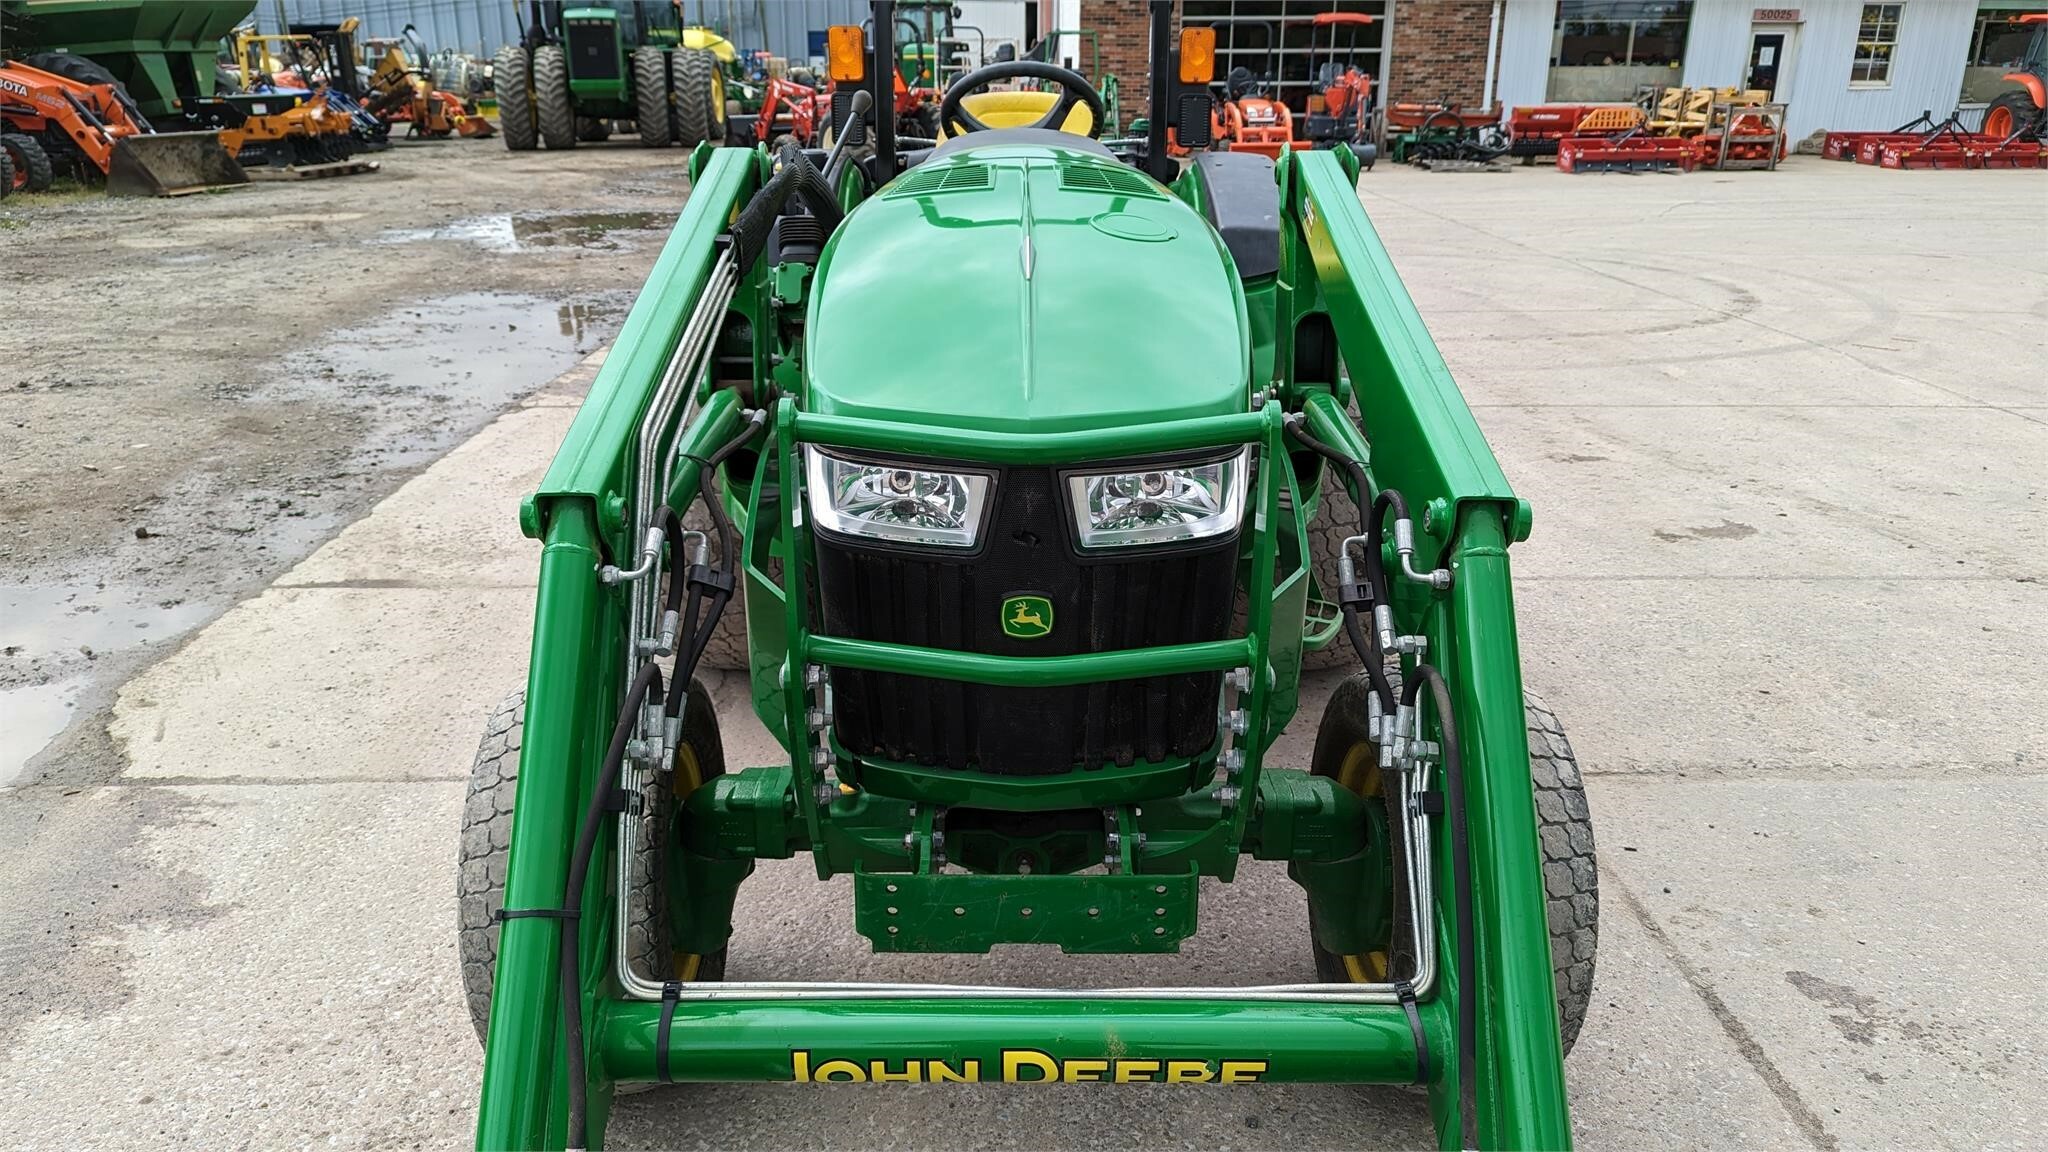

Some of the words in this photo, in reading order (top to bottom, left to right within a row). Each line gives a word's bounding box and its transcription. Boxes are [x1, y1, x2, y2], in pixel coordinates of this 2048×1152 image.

[1760, 10, 1793, 19] 50025
[788, 1049, 981, 1082] JOHN
[1000, 1048, 1270, 1082] DEERE
